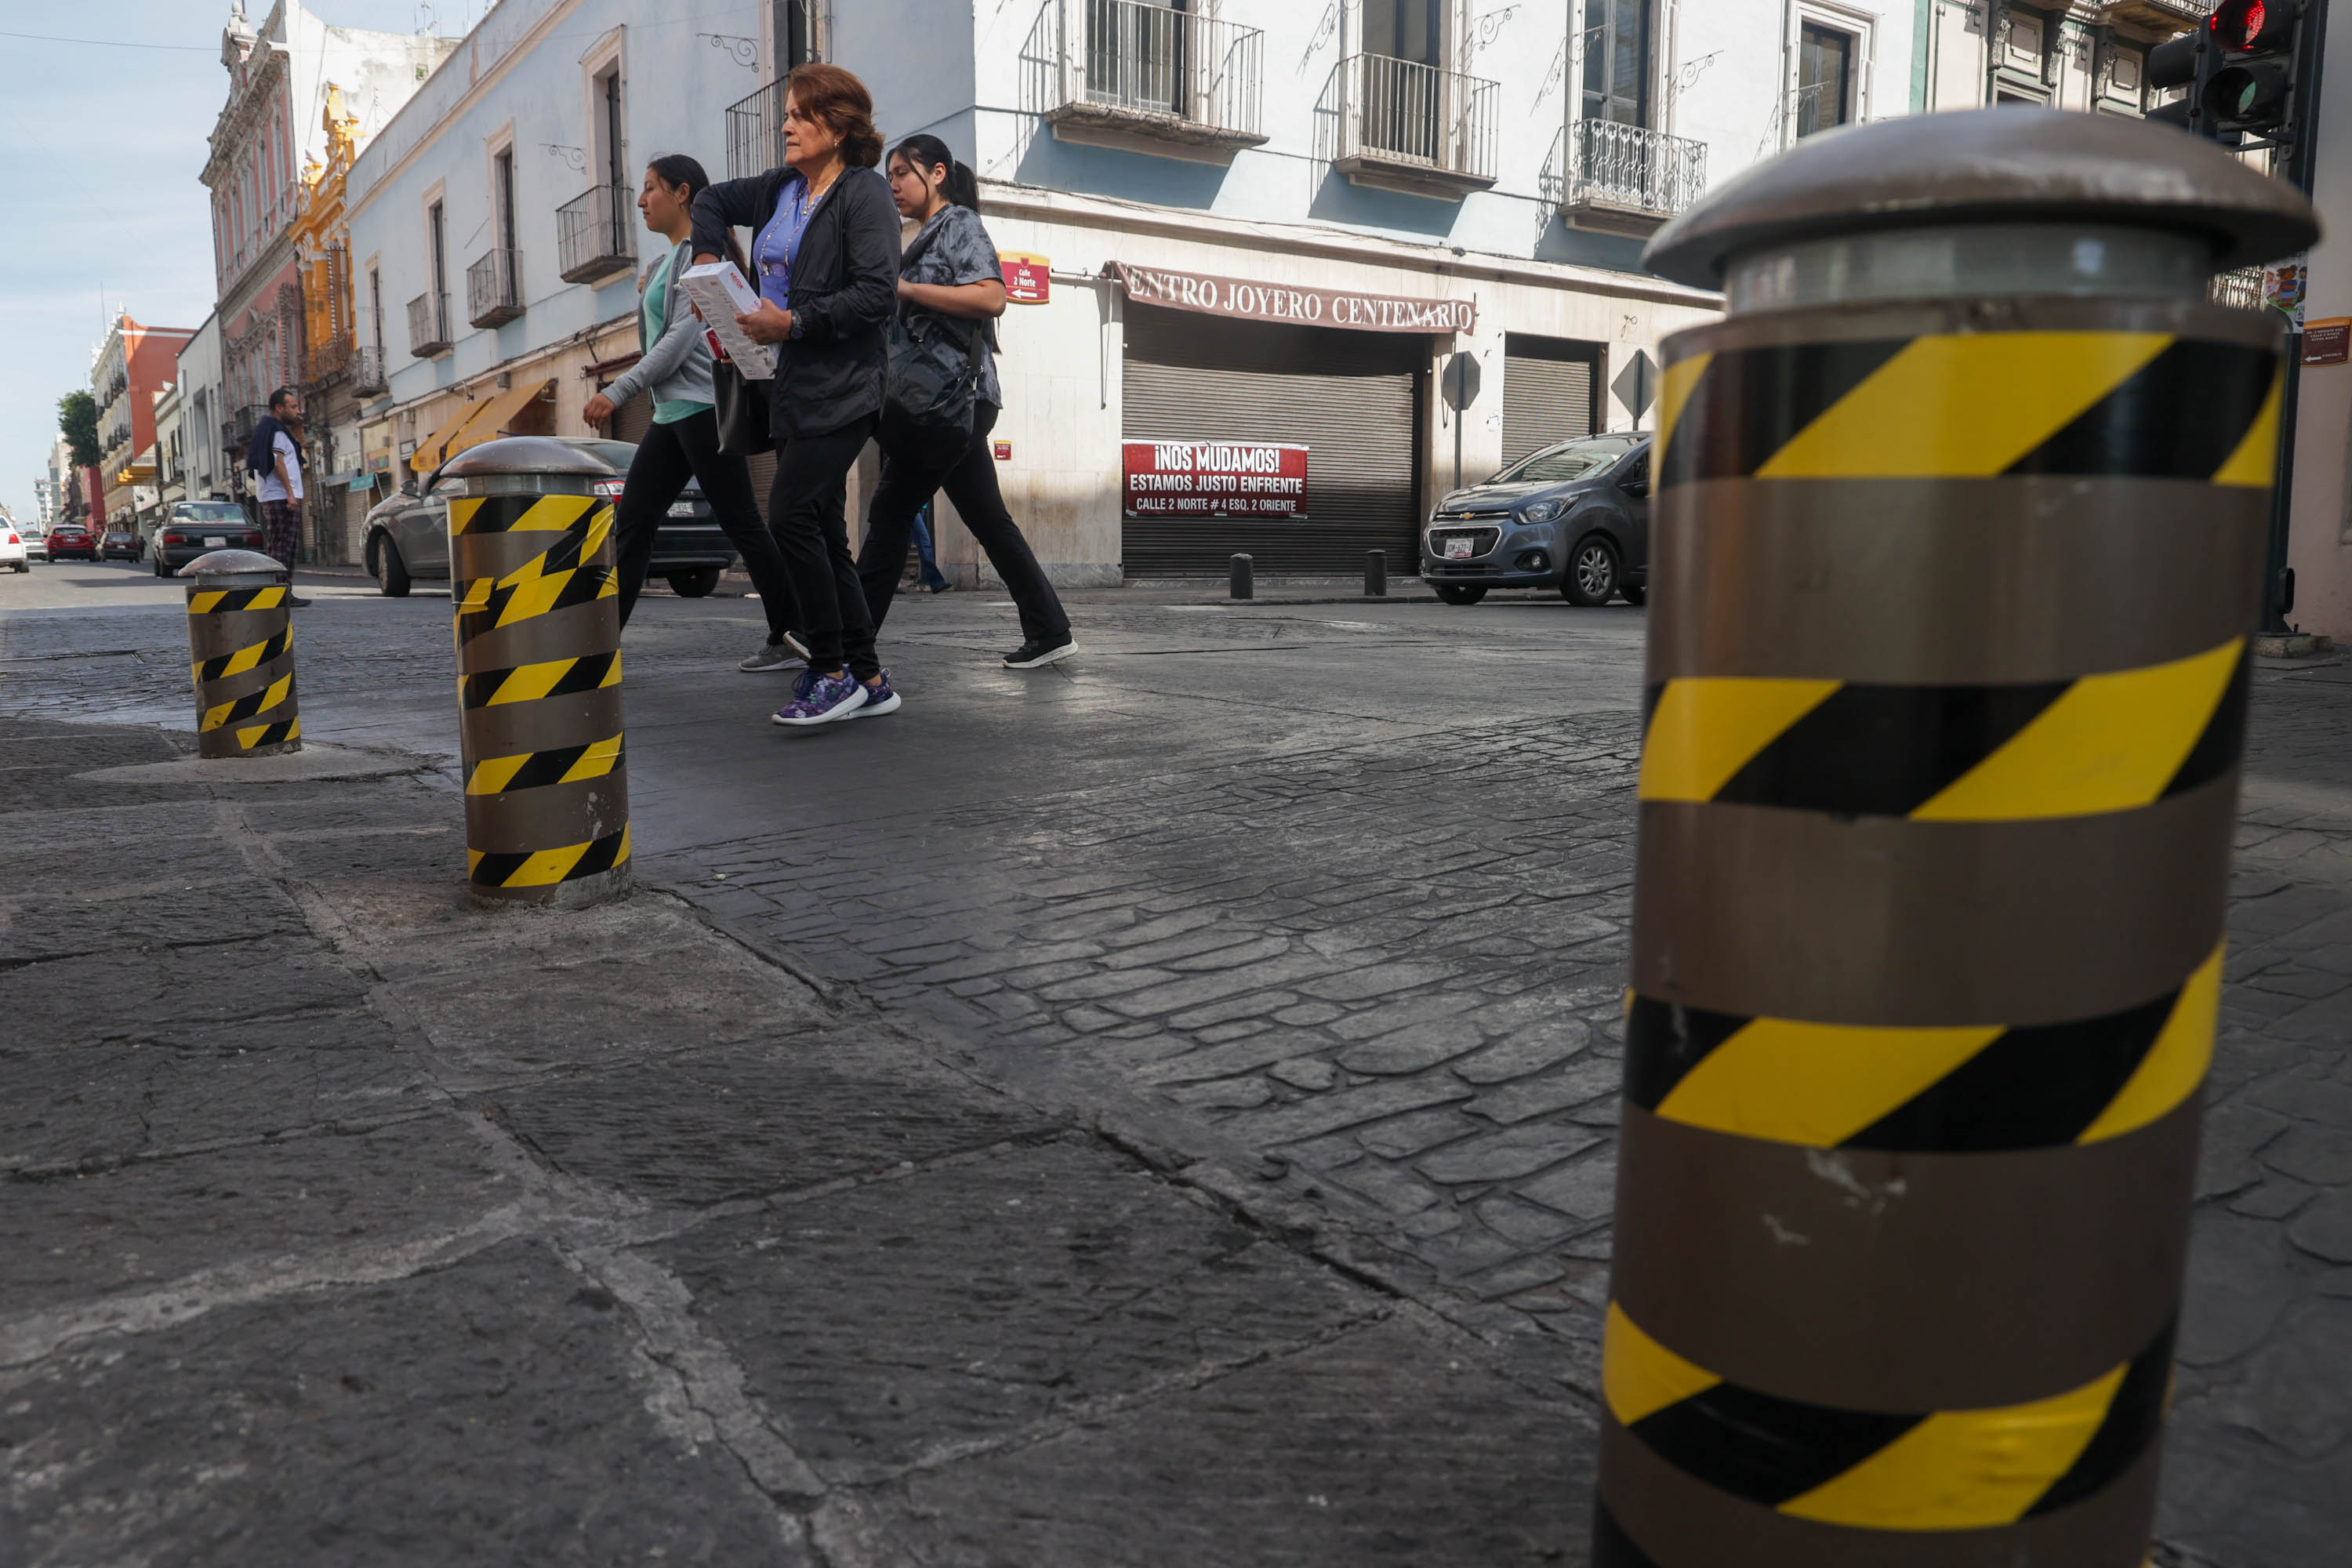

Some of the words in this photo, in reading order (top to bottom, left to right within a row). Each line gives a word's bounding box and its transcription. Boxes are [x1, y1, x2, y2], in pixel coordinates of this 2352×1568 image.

[728, 271, 743, 289] xerox
[1013, 276, 1018, 285] 2
[1018, 277, 1036, 288] Norte
[1127, 265, 1218, 308] ENTRO
[1223, 283, 1322, 321] JOYERO
[1332, 296, 1472, 329] CENTENARIO
[1154, 445, 1192, 470] ¡NOS
[1196, 445, 1280, 474] MUDAMOS!
[1130, 474, 1192, 492] ESTAMOS
[1196, 474, 1237, 492] JUSTO
[1240, 476, 1303, 494] ENFRENTE
[1136, 498, 1166, 510] CALLE
[1168, 498, 1174, 510] 2
[1177, 498, 1208, 510] NORTE
[1210, 499, 1219, 510] #
[1221, 499, 1227, 510] 4
[1229, 499, 1249, 511] ESQ.
[1251, 499, 1258, 510] 2
[1259, 499, 1297, 512] ORIENTE
